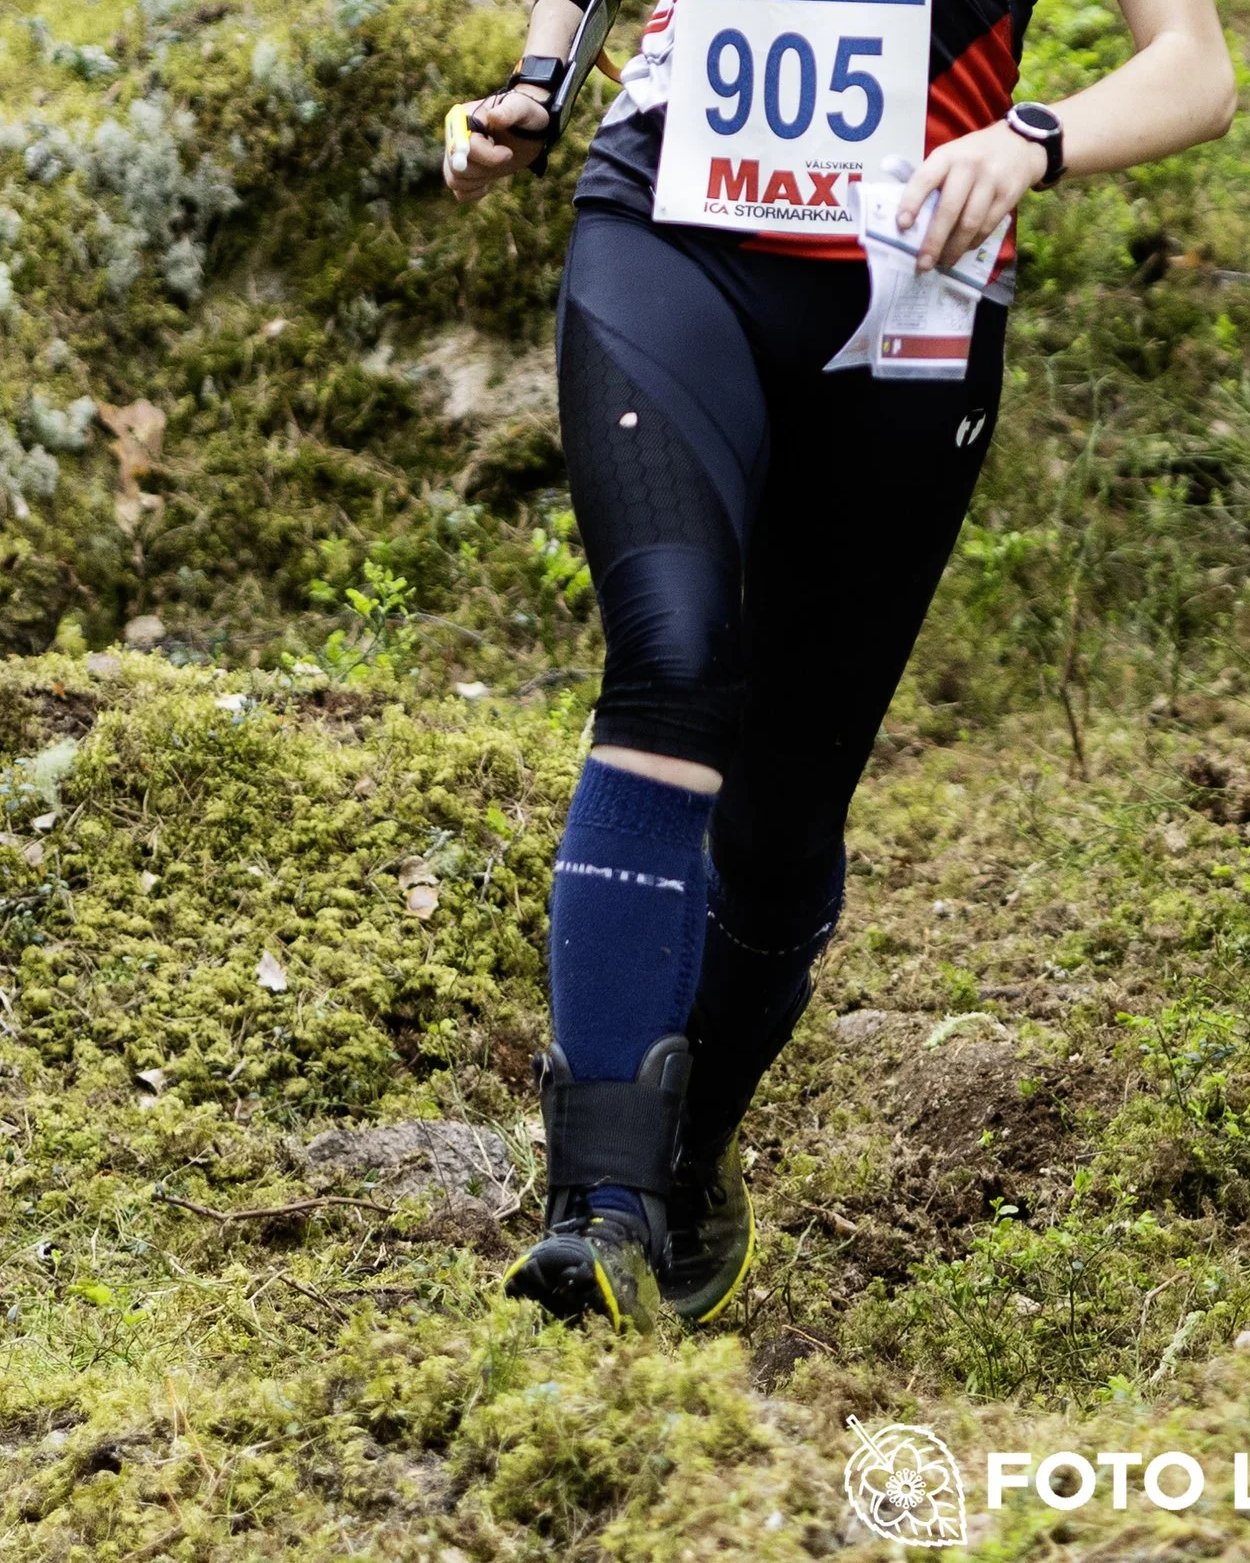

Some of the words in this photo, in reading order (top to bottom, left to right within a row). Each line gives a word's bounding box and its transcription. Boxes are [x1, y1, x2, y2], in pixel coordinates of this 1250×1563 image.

[705, 28, 884, 142] 905
[805, 159, 863, 170] VÄLSVIKEN
[703, 201, 729, 215] ICA
[734, 205, 853, 222] STORMARKNA
